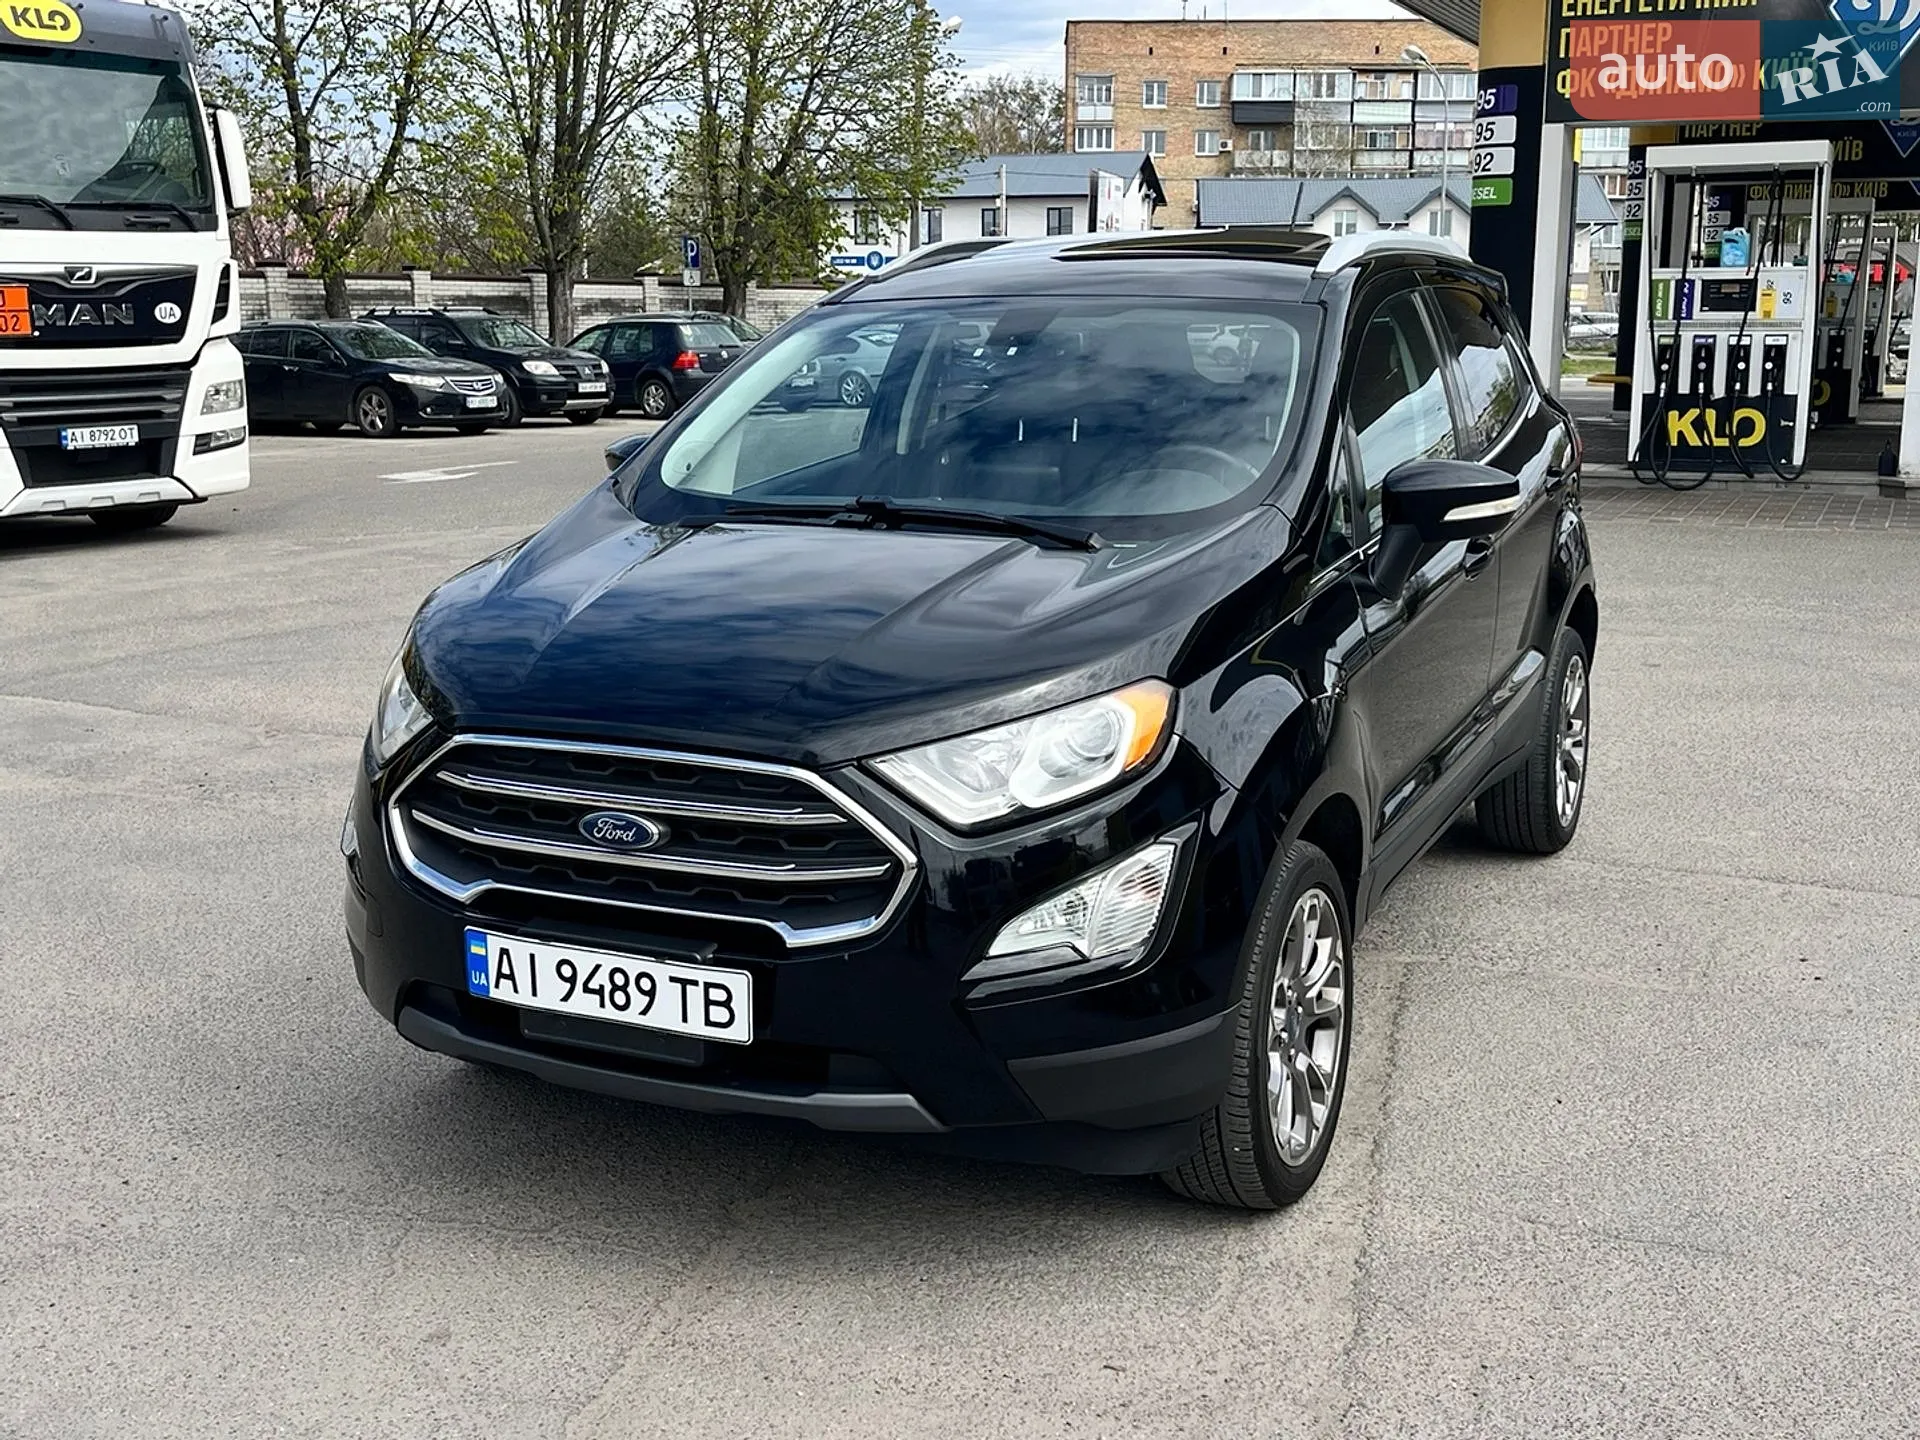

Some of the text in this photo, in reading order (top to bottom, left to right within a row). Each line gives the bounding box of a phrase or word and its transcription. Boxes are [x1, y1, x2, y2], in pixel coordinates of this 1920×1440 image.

[10, 6, 71, 31] KLO
[1558, 22, 1673, 58] ПАРТНЕР
[1556, 67, 1597, 99] ФК
[1477, 88, 1496, 110] 95
[1475, 121, 1496, 143] 95
[1830, 136, 1864, 161] ИЇВ
[1474, 152, 1494, 173] 92
[1782, 291, 1792, 304] 95
[32, 303, 135, 327] MAN
[159, 308, 177, 320] UA
[70, 427, 135, 443] AI 8792 OT
[1667, 407, 1767, 447] KLO
[593, 816, 637, 842] Ford
[471, 970, 488, 987] UA
[494, 947, 736, 1030] AI 9489 TB
